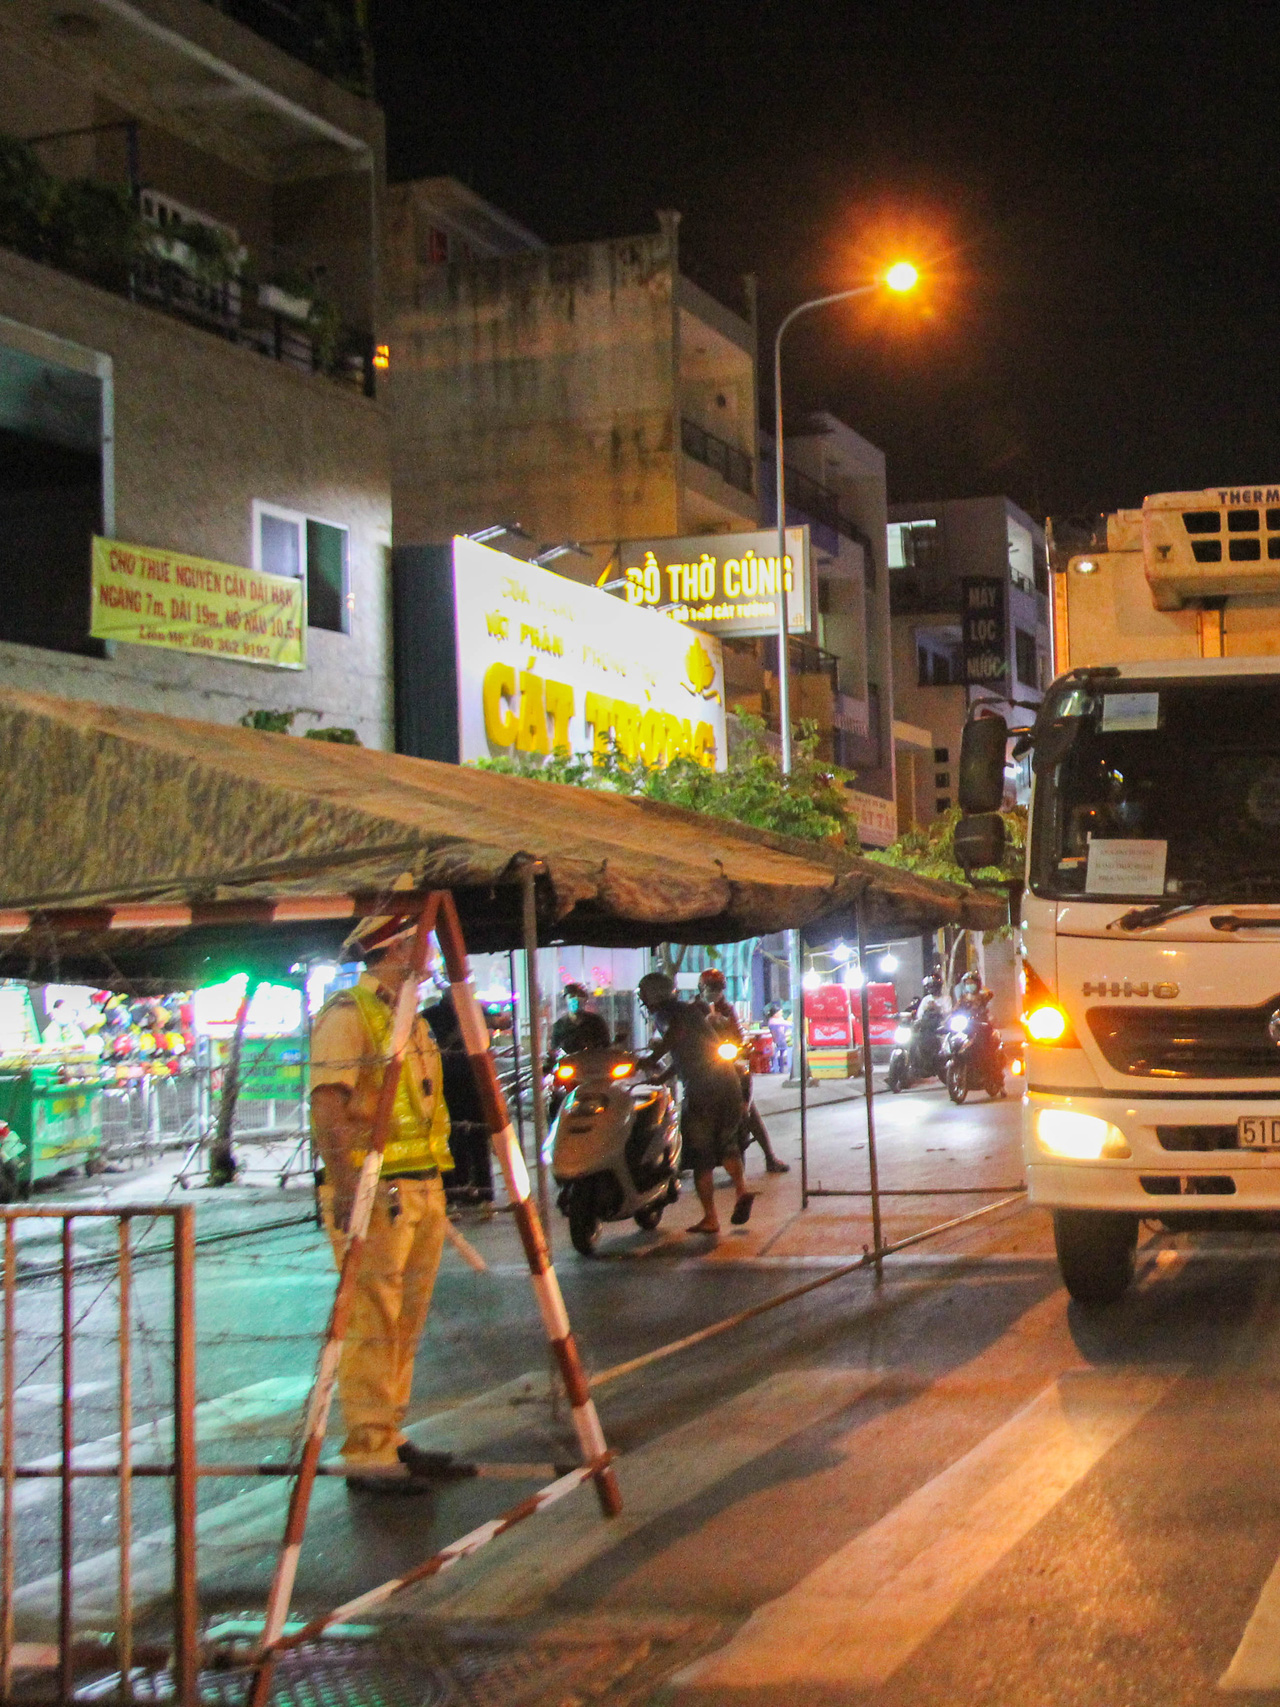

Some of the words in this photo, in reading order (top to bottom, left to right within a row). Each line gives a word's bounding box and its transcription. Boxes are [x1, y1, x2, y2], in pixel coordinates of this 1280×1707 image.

[109, 549, 137, 576] CHO
[624, 551, 661, 605] ĐỒ
[666, 553, 717, 602] THỜ
[723, 550, 793, 598] CÚNG
[100, 584, 142, 613] NGANG
[171, 595, 191, 622] DÀI
[483, 655, 575, 760] CÁT
[1082, 982, 1180, 999] HINO
